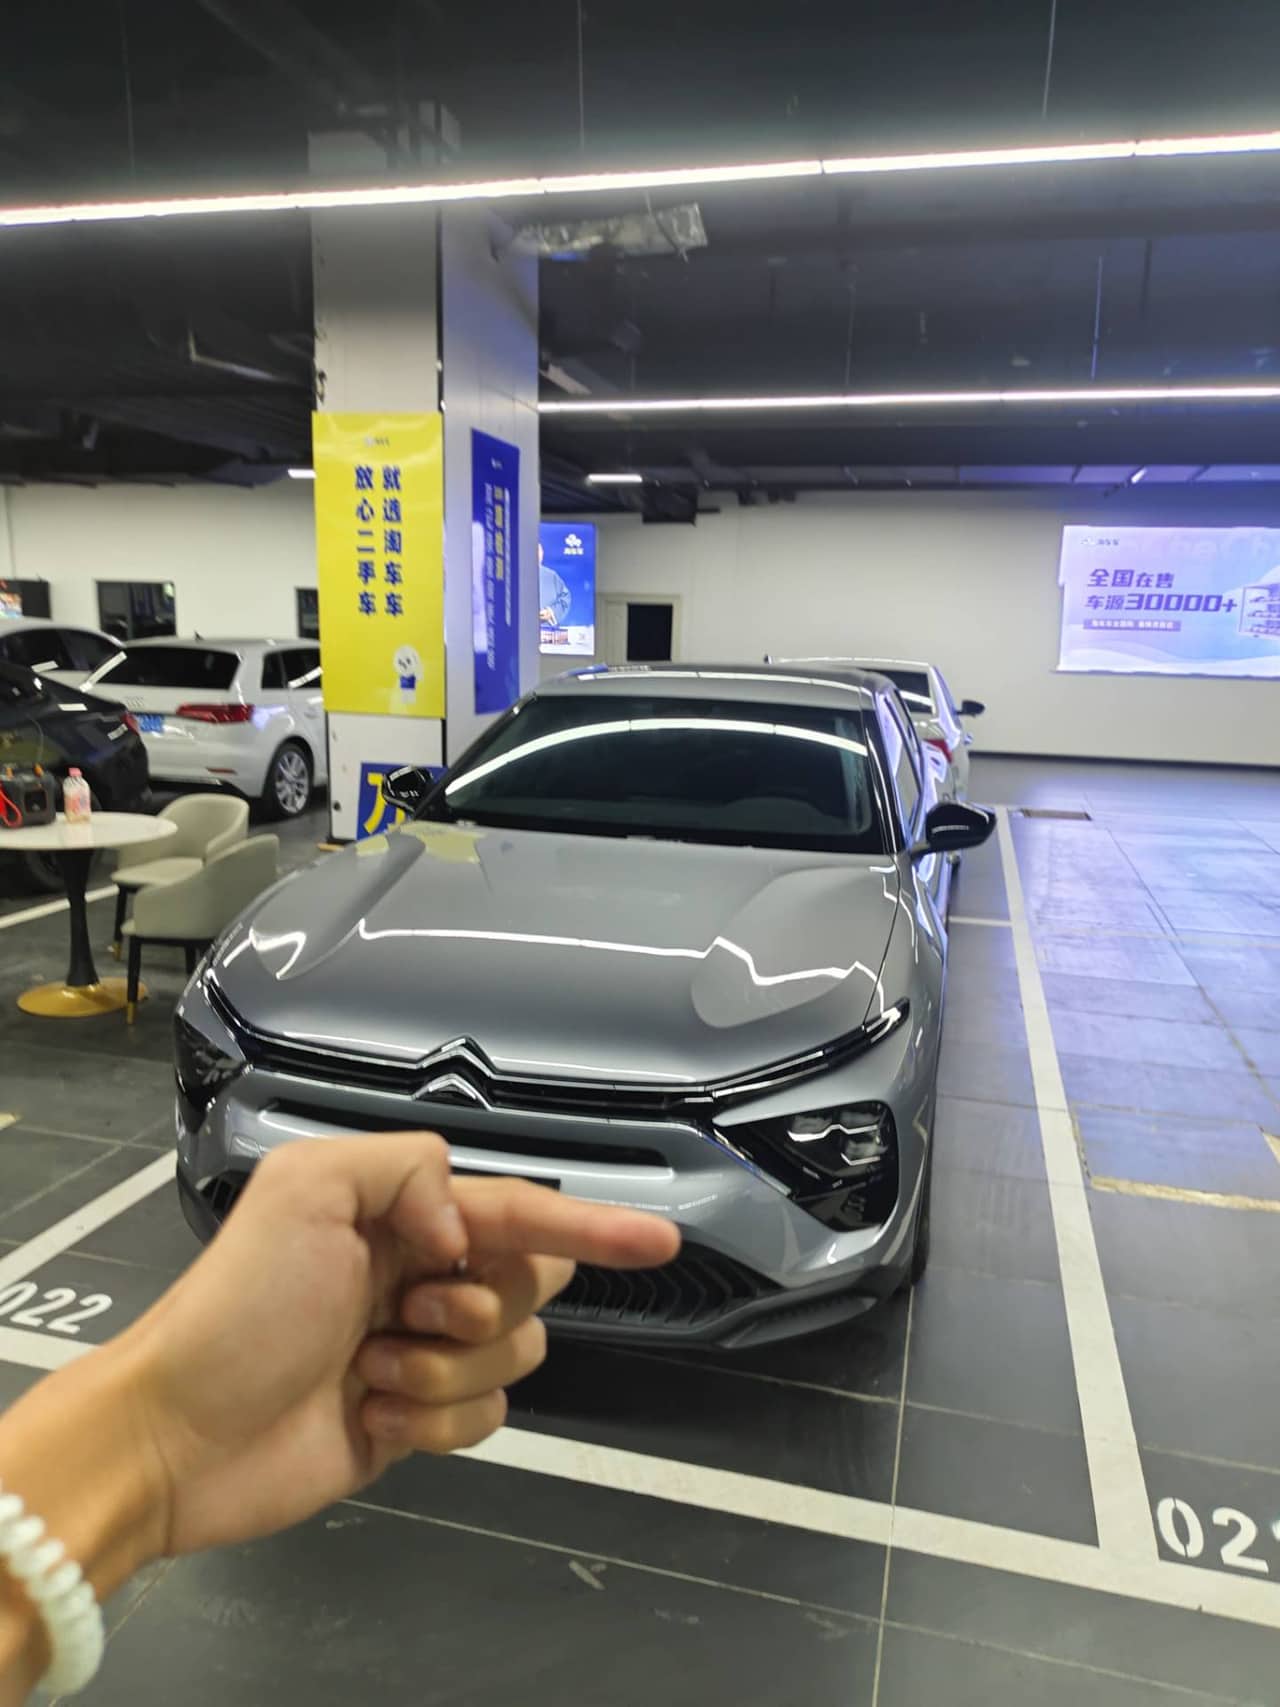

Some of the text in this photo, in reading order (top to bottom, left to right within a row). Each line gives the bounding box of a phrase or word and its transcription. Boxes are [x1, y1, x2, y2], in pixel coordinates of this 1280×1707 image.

[355, 464, 376, 616] 放心二手车
[382, 464, 403, 617] 就选淘车车
[1084, 593, 1238, 613] 车源30000+
[1087, 568, 1175, 589] 全国在售
[0, 1281, 113, 1335] 022
[1157, 1496, 1280, 1574] 02
